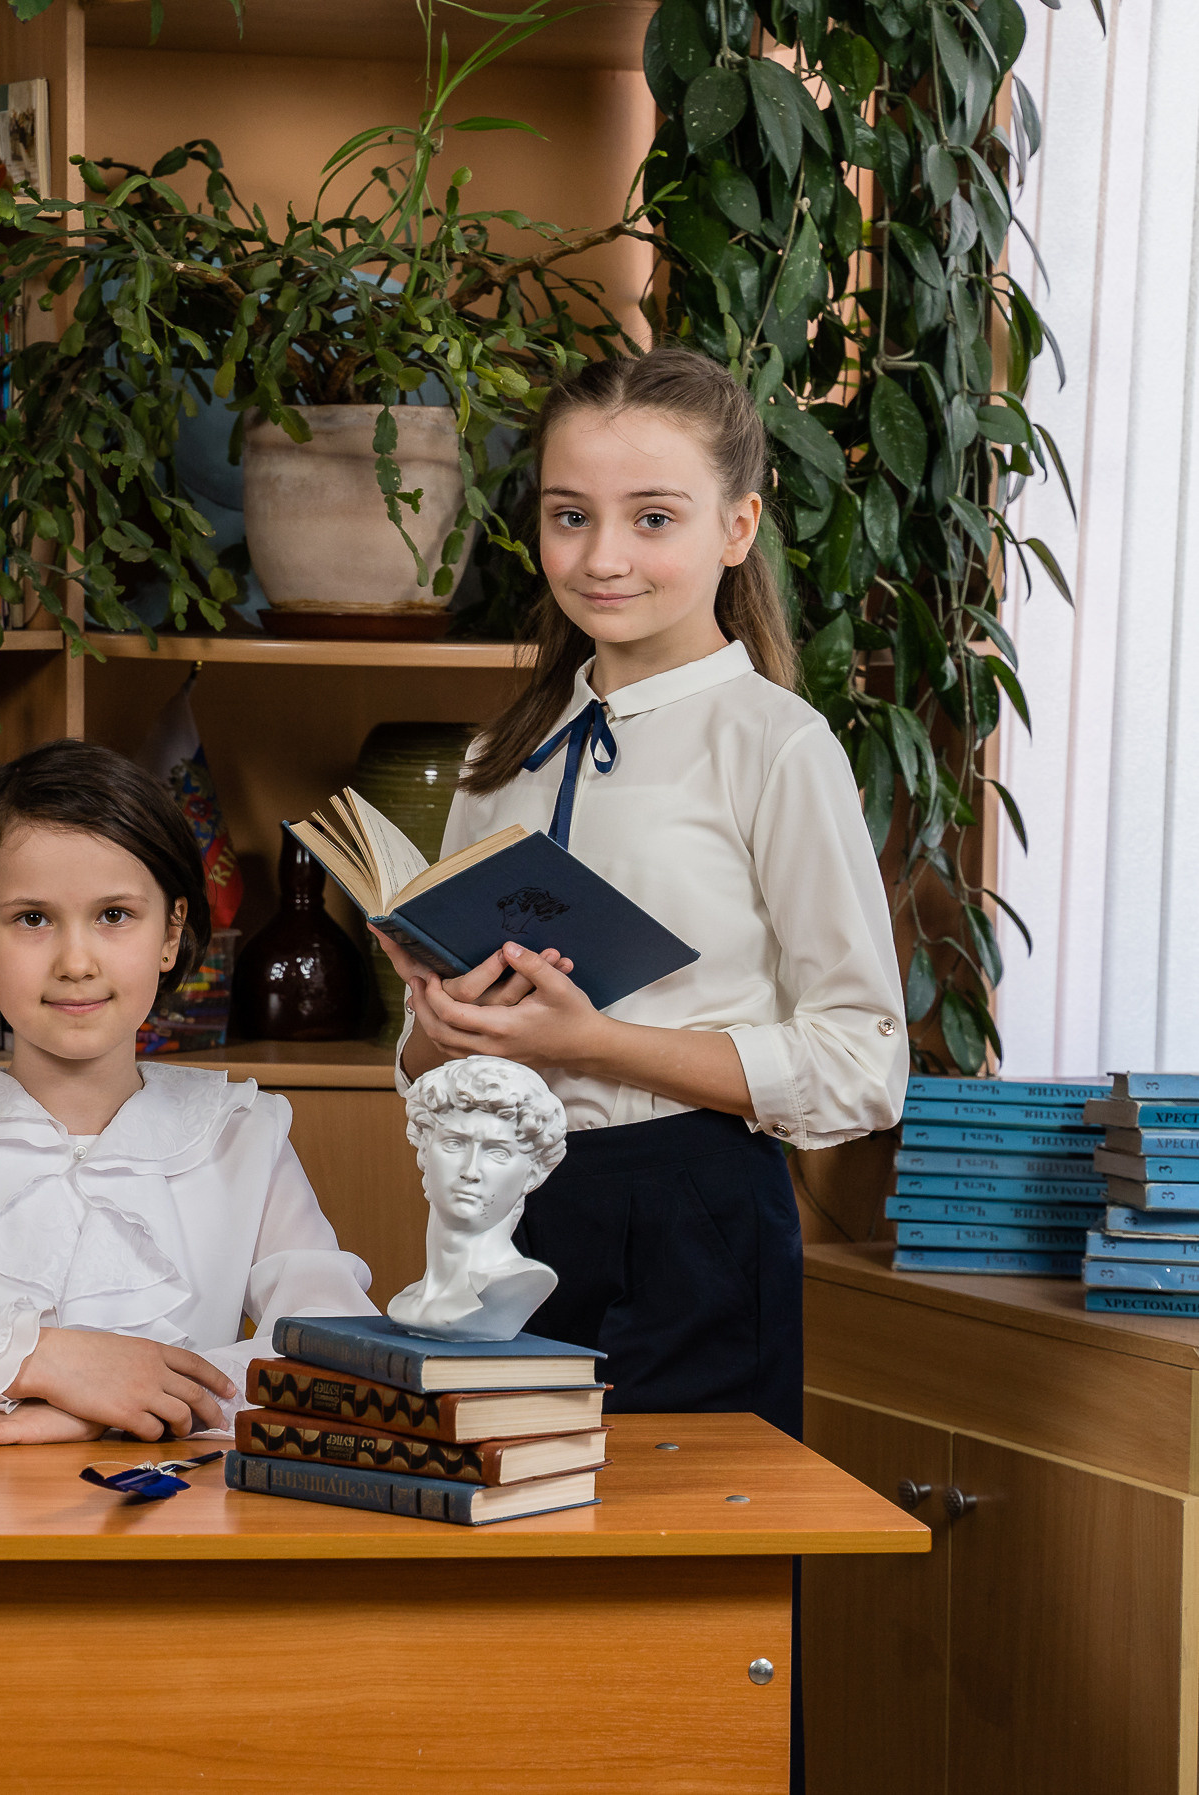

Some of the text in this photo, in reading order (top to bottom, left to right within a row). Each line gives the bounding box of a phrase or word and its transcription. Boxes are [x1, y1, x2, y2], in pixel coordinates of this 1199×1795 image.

[1146, 1081, 1159, 1090] 3
[1159, 1165, 1172, 1174] 3
[1161, 1191, 1175, 1200] 3
[314, 1380, 340, 1394] КУПЕР
[326, 1433, 355, 1447] КУПЕР
[361, 1439, 376, 1450] 3
[272, 1467, 352, 1498] ПУШКИН
